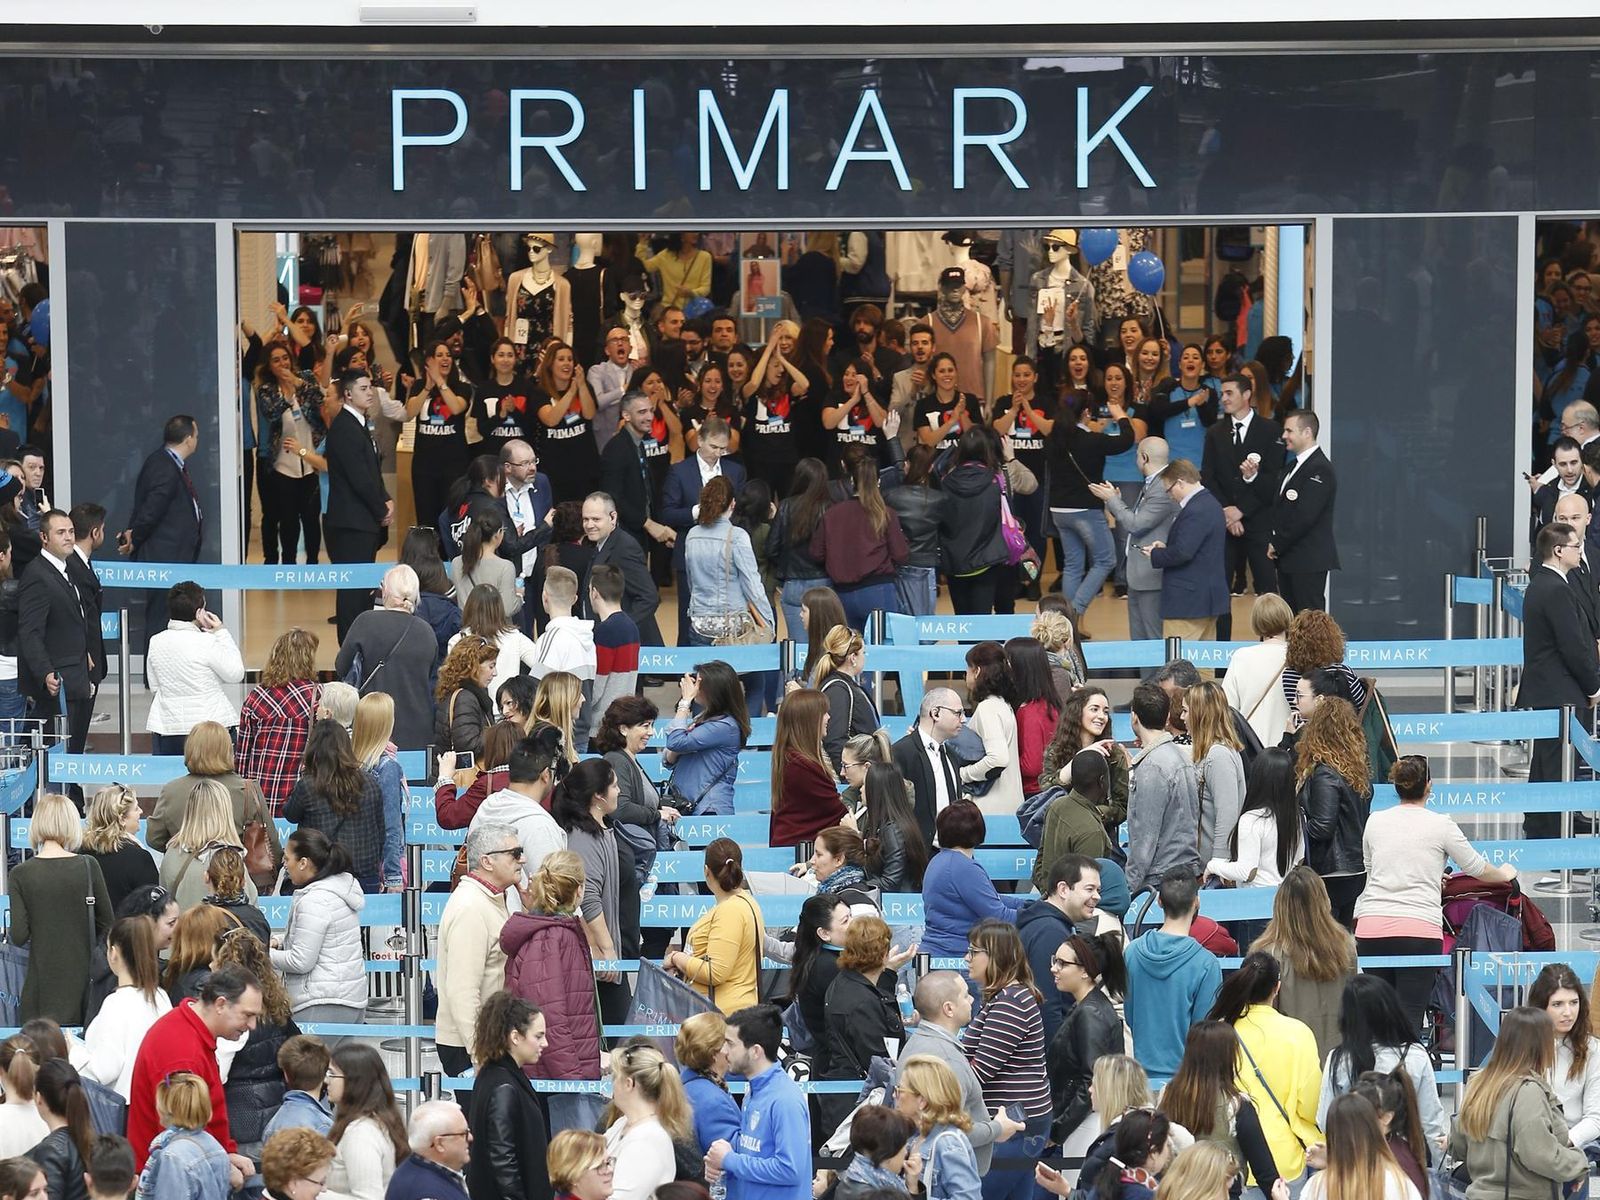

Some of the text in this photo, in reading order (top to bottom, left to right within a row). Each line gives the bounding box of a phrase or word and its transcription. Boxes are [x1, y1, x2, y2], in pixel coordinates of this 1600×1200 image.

[392, 86, 1157, 191] PRIMARK
[275, 571, 351, 583] PRIMARK
[921, 622, 971, 634] MARK
[1349, 648, 1430, 661] PRIMARK
[54, 761, 144, 776] PRIMARK
[1428, 790, 1504, 805] RIMARK
[643, 904, 709, 918] PRIMA
[536, 1081, 609, 1092] PRIMARK
